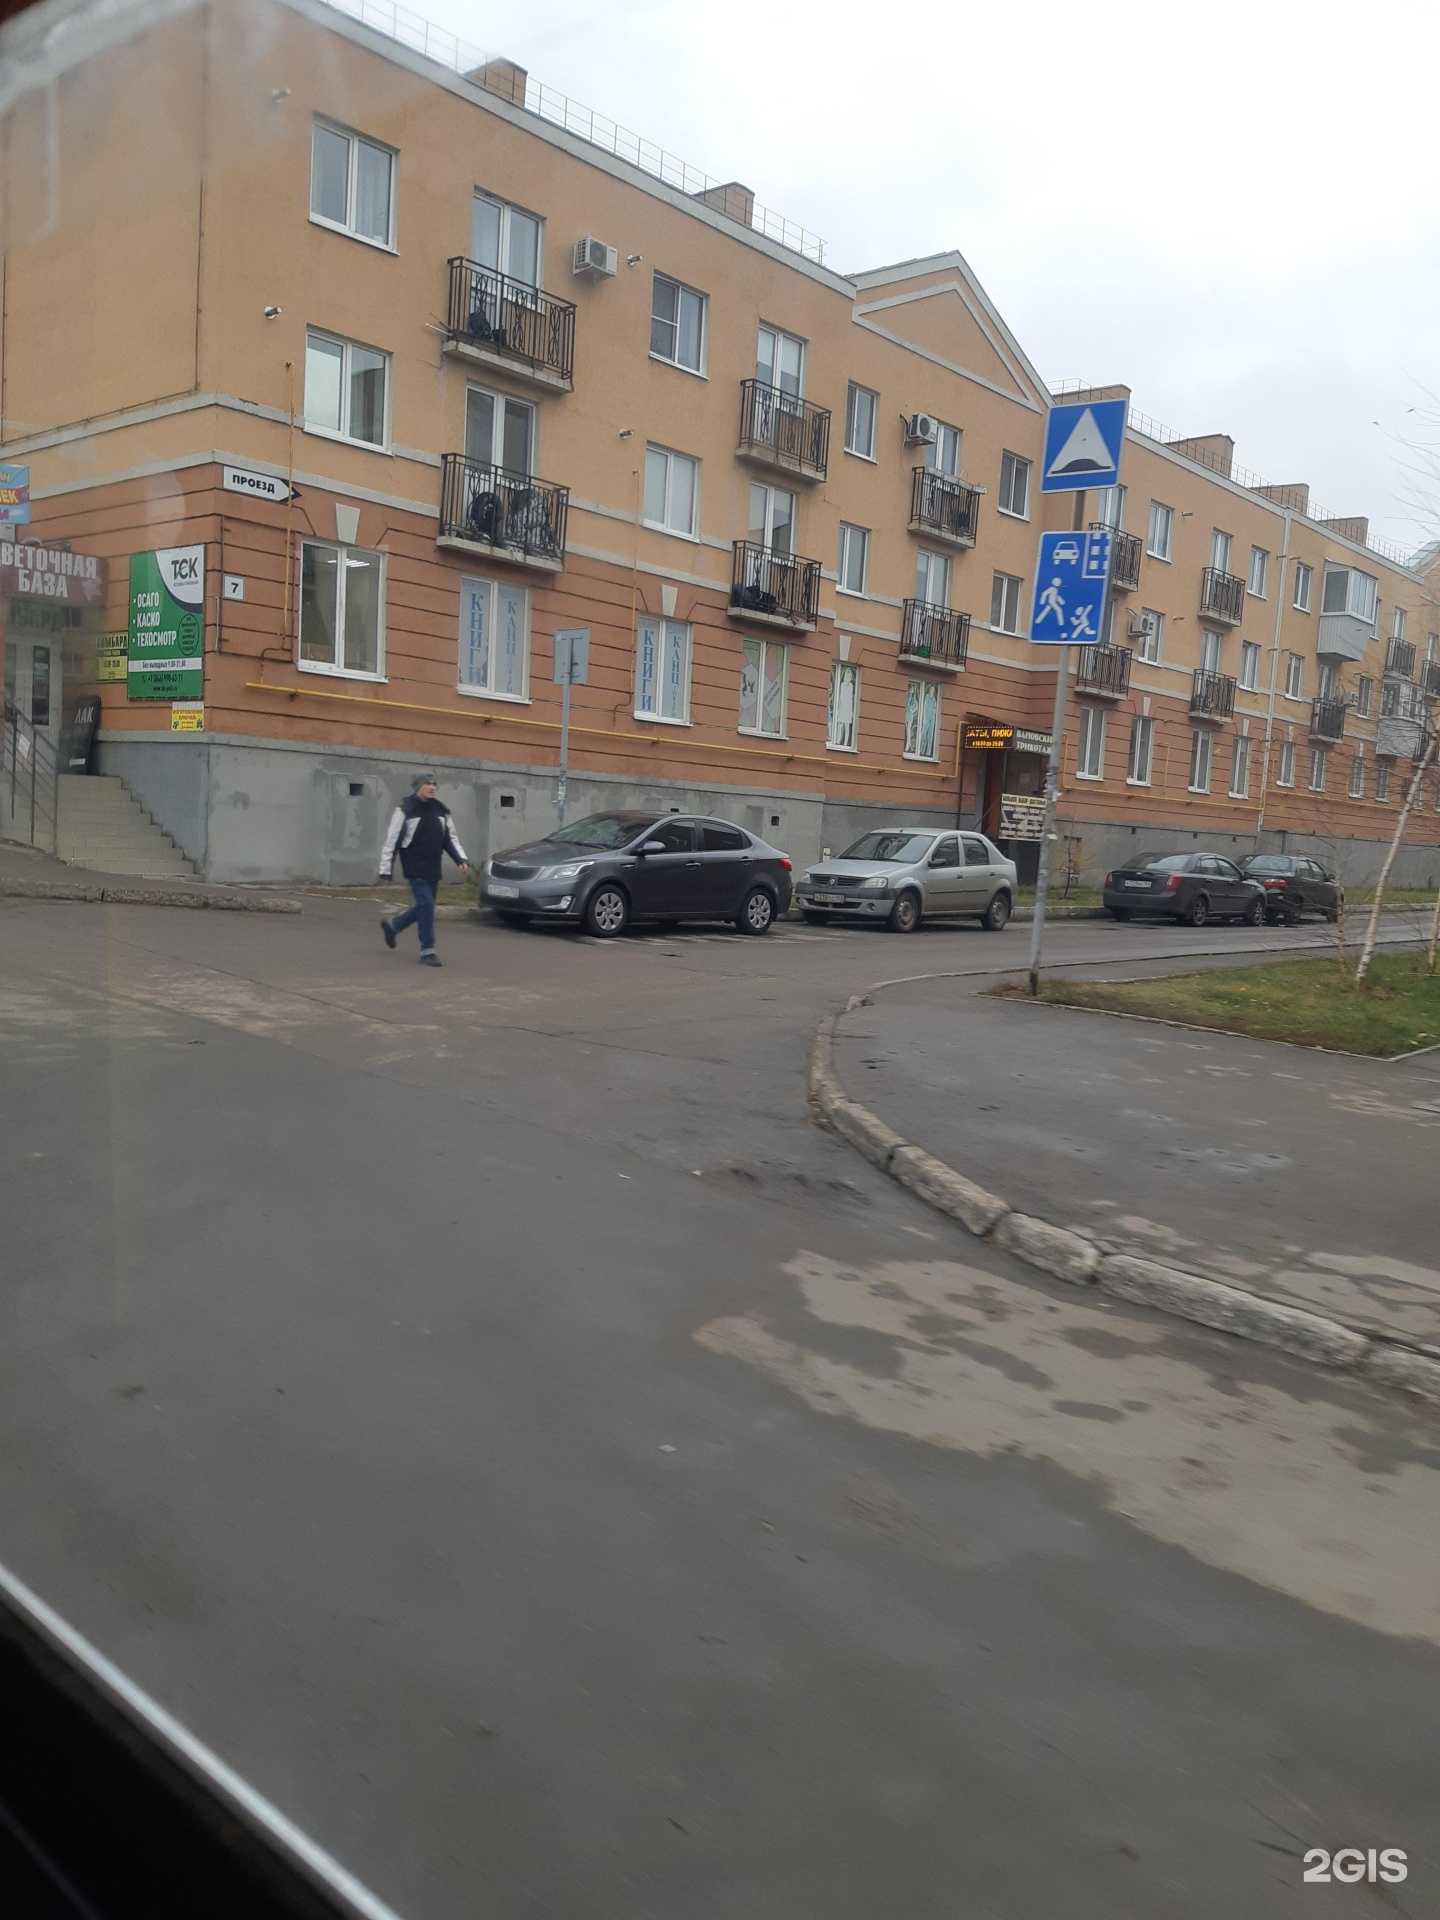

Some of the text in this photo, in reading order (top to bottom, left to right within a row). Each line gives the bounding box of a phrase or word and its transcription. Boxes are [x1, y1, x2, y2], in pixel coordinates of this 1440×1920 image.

[232, 474, 275, 494] ПРОЕЗД
[0, 541, 97, 580] ВЕТОЧНАЯ
[18, 568, 69, 598] БАЗА
[231, 582, 239, 594] 7
[137, 592, 160, 608] ОСАГО
[137, 611, 160, 628] КАСКО
[137, 630, 177, 647] ТЕХОСМОТР
[469, 592, 484, 684] КНИГИ
[641, 629, 655, 711] КНИГИ
